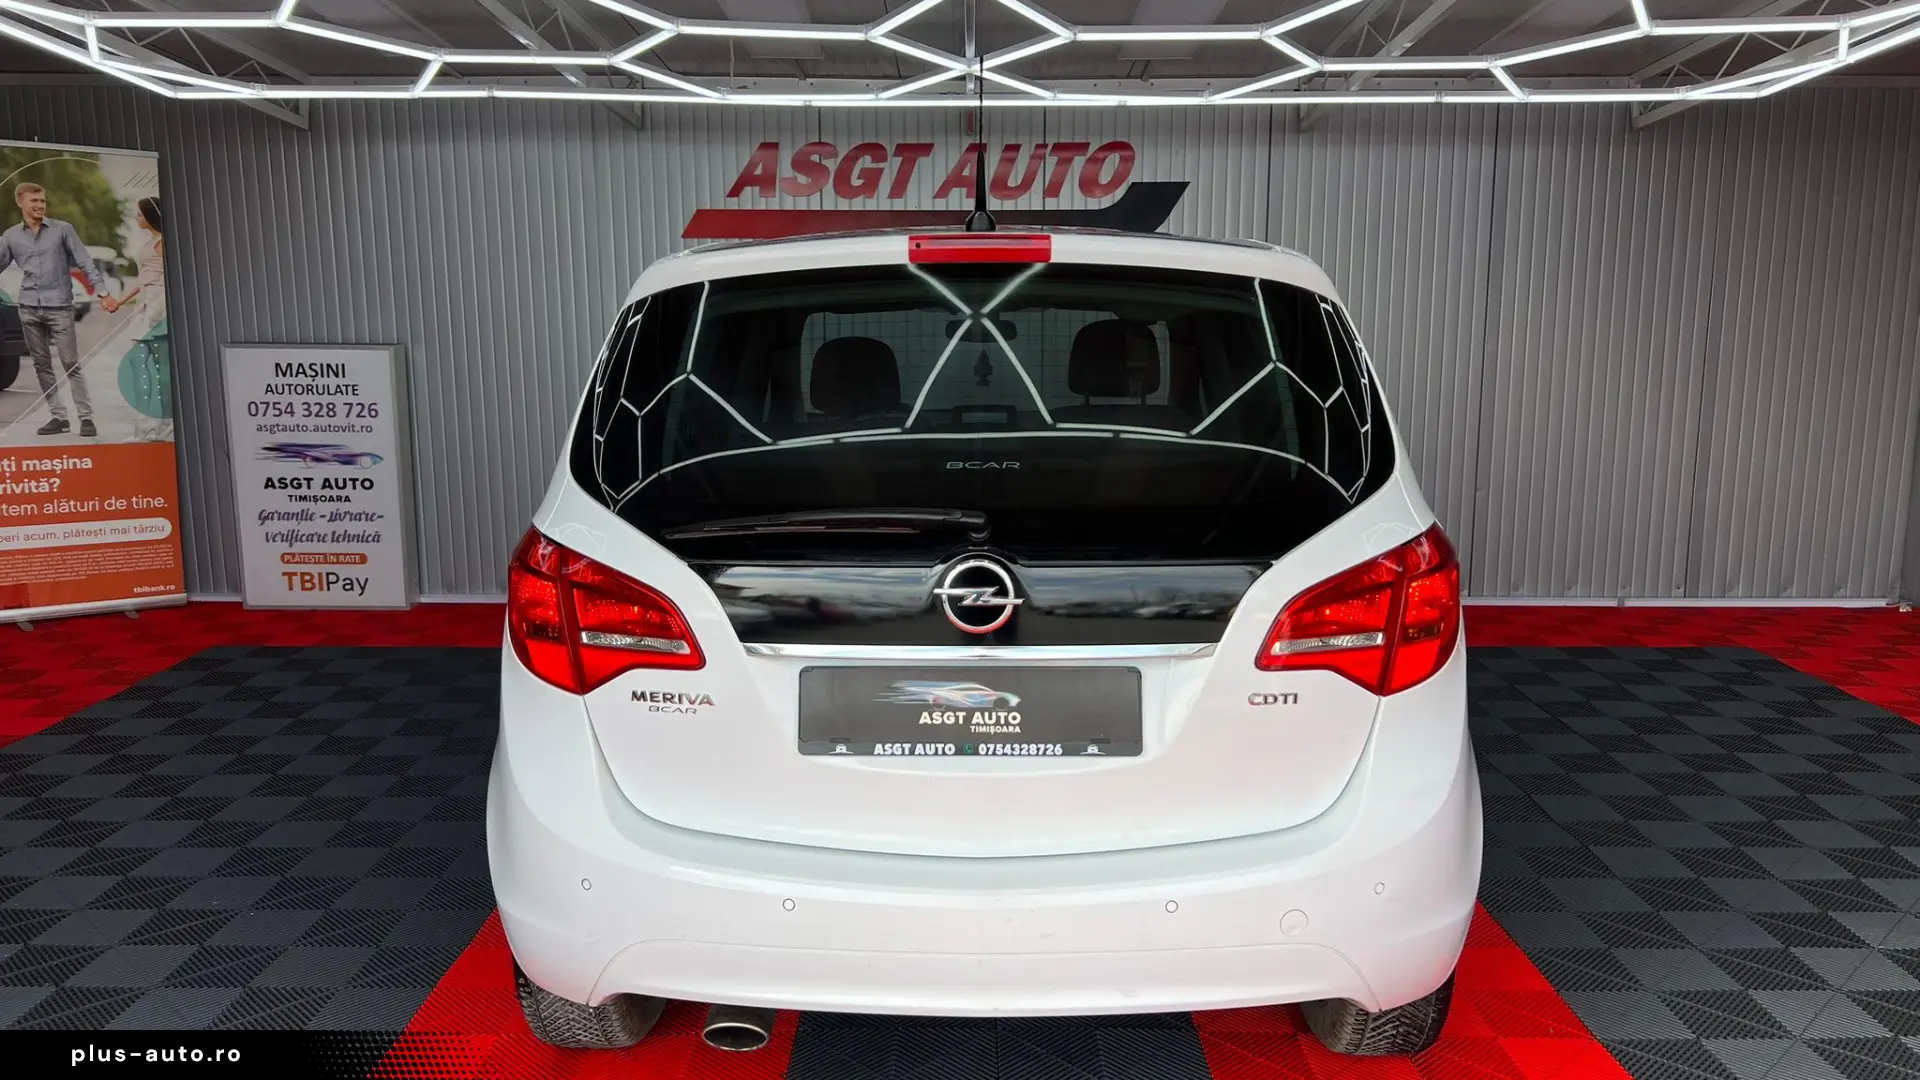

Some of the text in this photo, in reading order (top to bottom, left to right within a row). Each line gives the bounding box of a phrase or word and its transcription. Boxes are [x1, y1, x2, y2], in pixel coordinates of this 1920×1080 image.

[726, 141, 1136, 199] ASGT AUTO
[275, 362, 346, 382] MAȘINI
[264, 384, 359, 396] AUTORULATE
[247, 401, 379, 418] 0754 328 726
[256, 422, 373, 434] asgtauto.autovit.ro
[0, 455, 92, 477] ți mașina
[946, 461, 1020, 469] BCAR
[264, 477, 374, 491] ASGT AUTO
[43, 497, 99, 514] alături
[104, 496, 127, 511] de
[131, 495, 168, 509] tine.
[288, 494, 352, 505] TIMIȘOARA
[110, 526, 132, 536] mai
[265, 529, 382, 548] verificare tehnică
[133, 585, 175, 593] tbibank.ro
[281, 571, 369, 596] TBIPay
[631, 690, 715, 706] MERIVA
[1248, 692, 1298, 706] CDTI
[919, 712, 1022, 725] ASGT AUTO
[873, 743, 1063, 755] ASGT AUTO 0754328726
